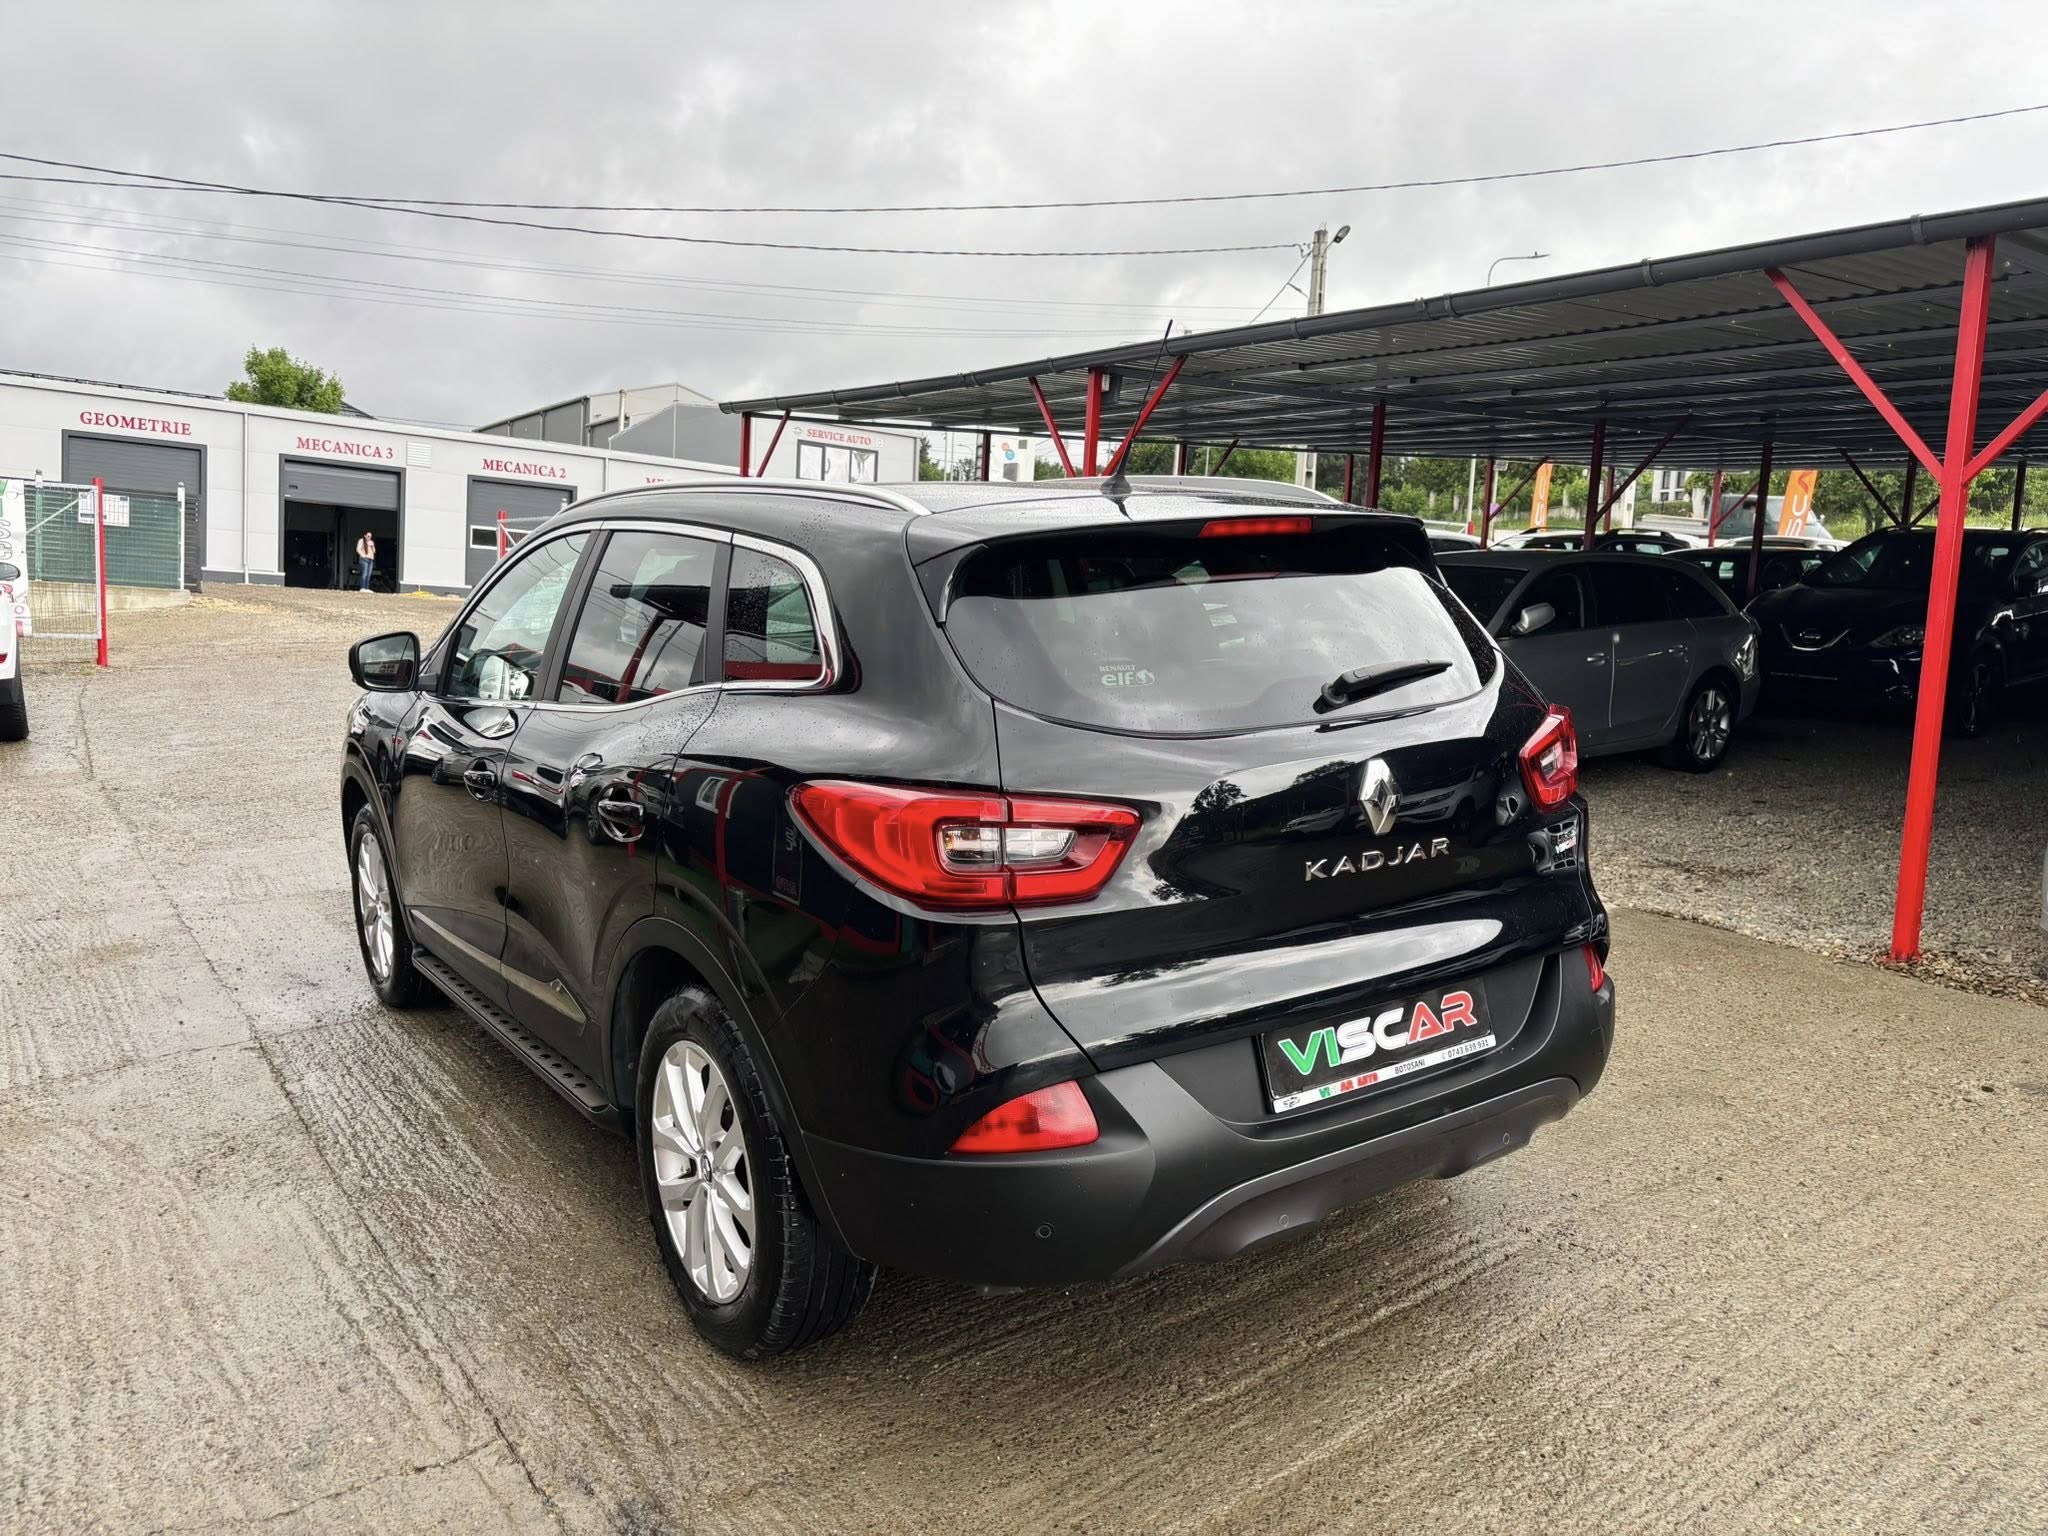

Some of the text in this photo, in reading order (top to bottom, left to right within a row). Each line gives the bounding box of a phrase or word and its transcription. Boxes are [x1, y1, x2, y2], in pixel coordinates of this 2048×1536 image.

[80, 411, 192, 435] GEOMETRIE
[807, 428, 872, 446] SERVICE AUTO
[296, 437, 394, 460] MECANICA 3
[482, 458, 567, 479] MECANICA 2
[1101, 671, 1135, 686] elf
[1305, 837, 1450, 881] KADJAR
[1277, 990, 1478, 1077] VISCAR
[1394, 1059, 1426, 1075] BOTOSANI
